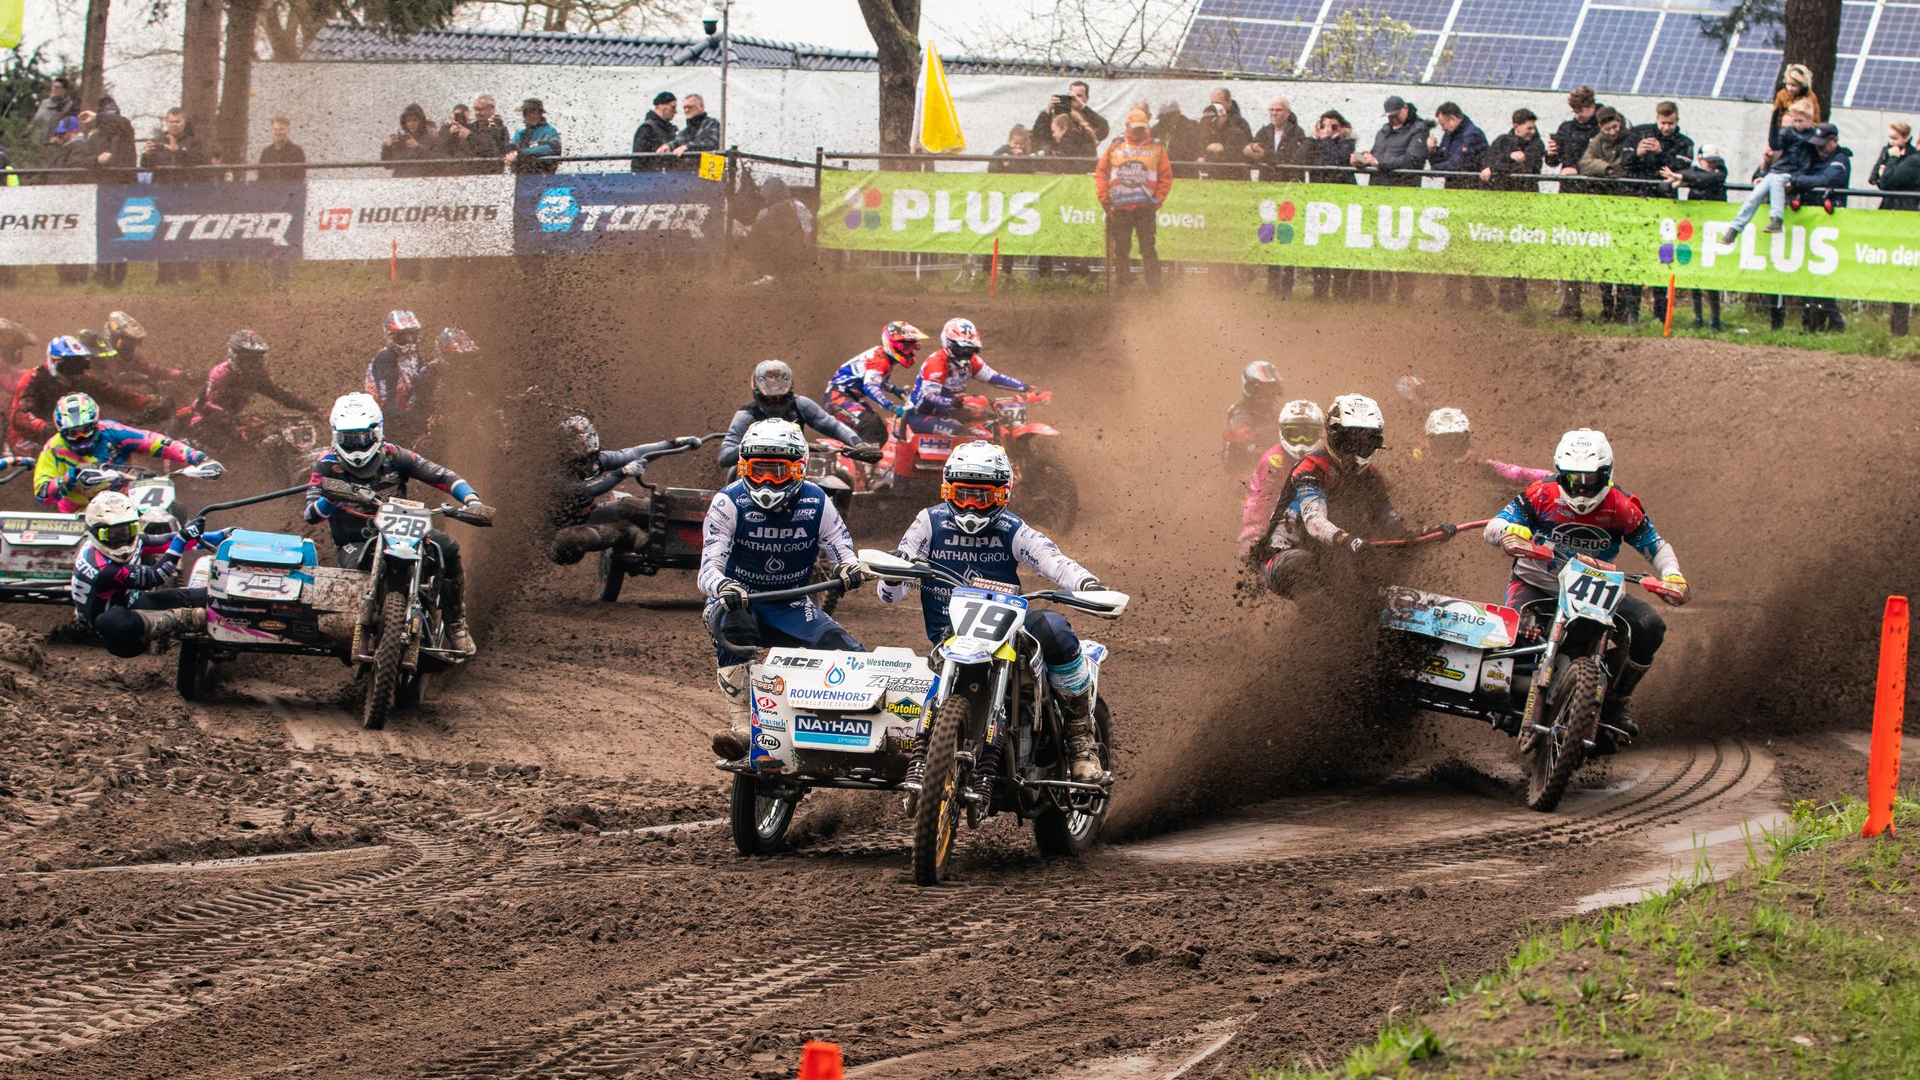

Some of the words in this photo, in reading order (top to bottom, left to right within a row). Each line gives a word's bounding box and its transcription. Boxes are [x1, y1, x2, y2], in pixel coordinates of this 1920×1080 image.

[359, 204, 498, 225] HOCOPARTS
[891, 187, 1042, 236] PLUS
[1060, 205, 1095, 225] Van
[1158, 212, 1205, 229] oven
[1304, 200, 1451, 252] PLUS
[1468, 222, 1504, 243] Van
[1508, 222, 1547, 245] den
[1550, 226, 1612, 248] Hoven
[1702, 221, 1839, 276] PLUS
[1856, 243, 1887, 265] Van
[140, 487, 165, 507] 4
[380, 515, 427, 538] 238
[749, 526, 808, 539] JOPA
[736, 538, 782, 553] NATHAN
[944, 535, 1004, 548] JOPA
[1571, 535, 1611, 551] BRUG
[931, 550, 978, 562] NATHAN
[734, 565, 810, 581] ROUWENHORST
[972, 581, 1014, 593] RENTHAL
[1567, 574, 1621, 611] 411
[957, 601, 1018, 642] 19
[1451, 611, 1486, 627] BRUG
[771, 655, 824, 669] MCE
[866, 657, 912, 672] Westendorp
[866, 674, 934, 690] Action
[790, 688, 873, 702] ROUWENHORST
[758, 708, 778, 716] JOPA
[887, 701, 921, 715] Putolin
[798, 717, 870, 735] NATHAN
[758, 735, 778, 747] Arai
